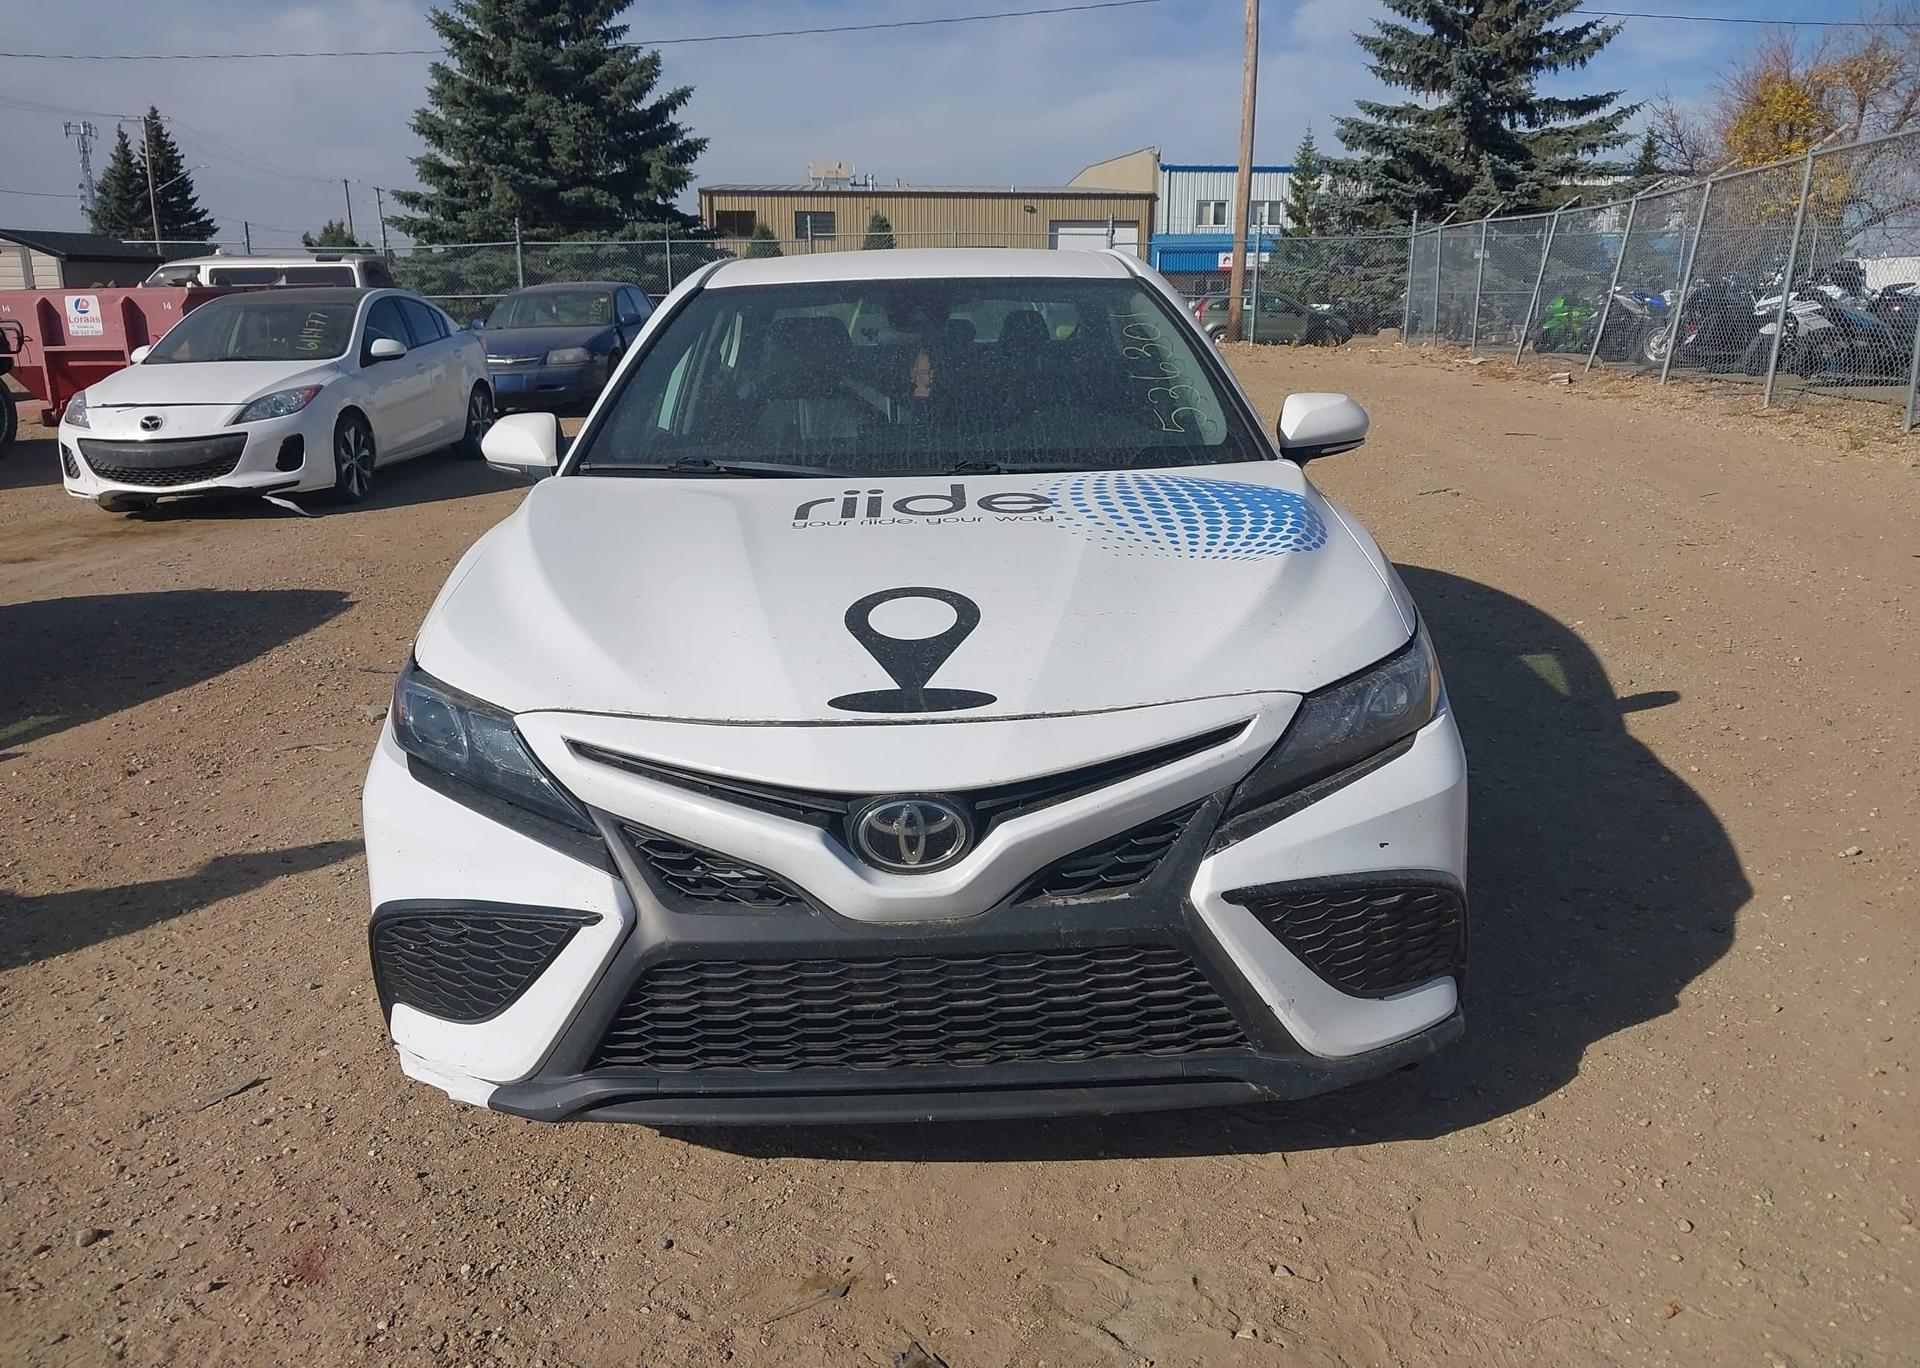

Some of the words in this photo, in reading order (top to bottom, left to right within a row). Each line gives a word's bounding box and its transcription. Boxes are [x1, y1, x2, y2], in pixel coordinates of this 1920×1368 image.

[69, 315, 101, 324] Loraas
[1110, 312, 1207, 433] 536301
[794, 483, 1054, 520] riide
[792, 520, 852, 530] your
[926, 515, 984, 526] your
